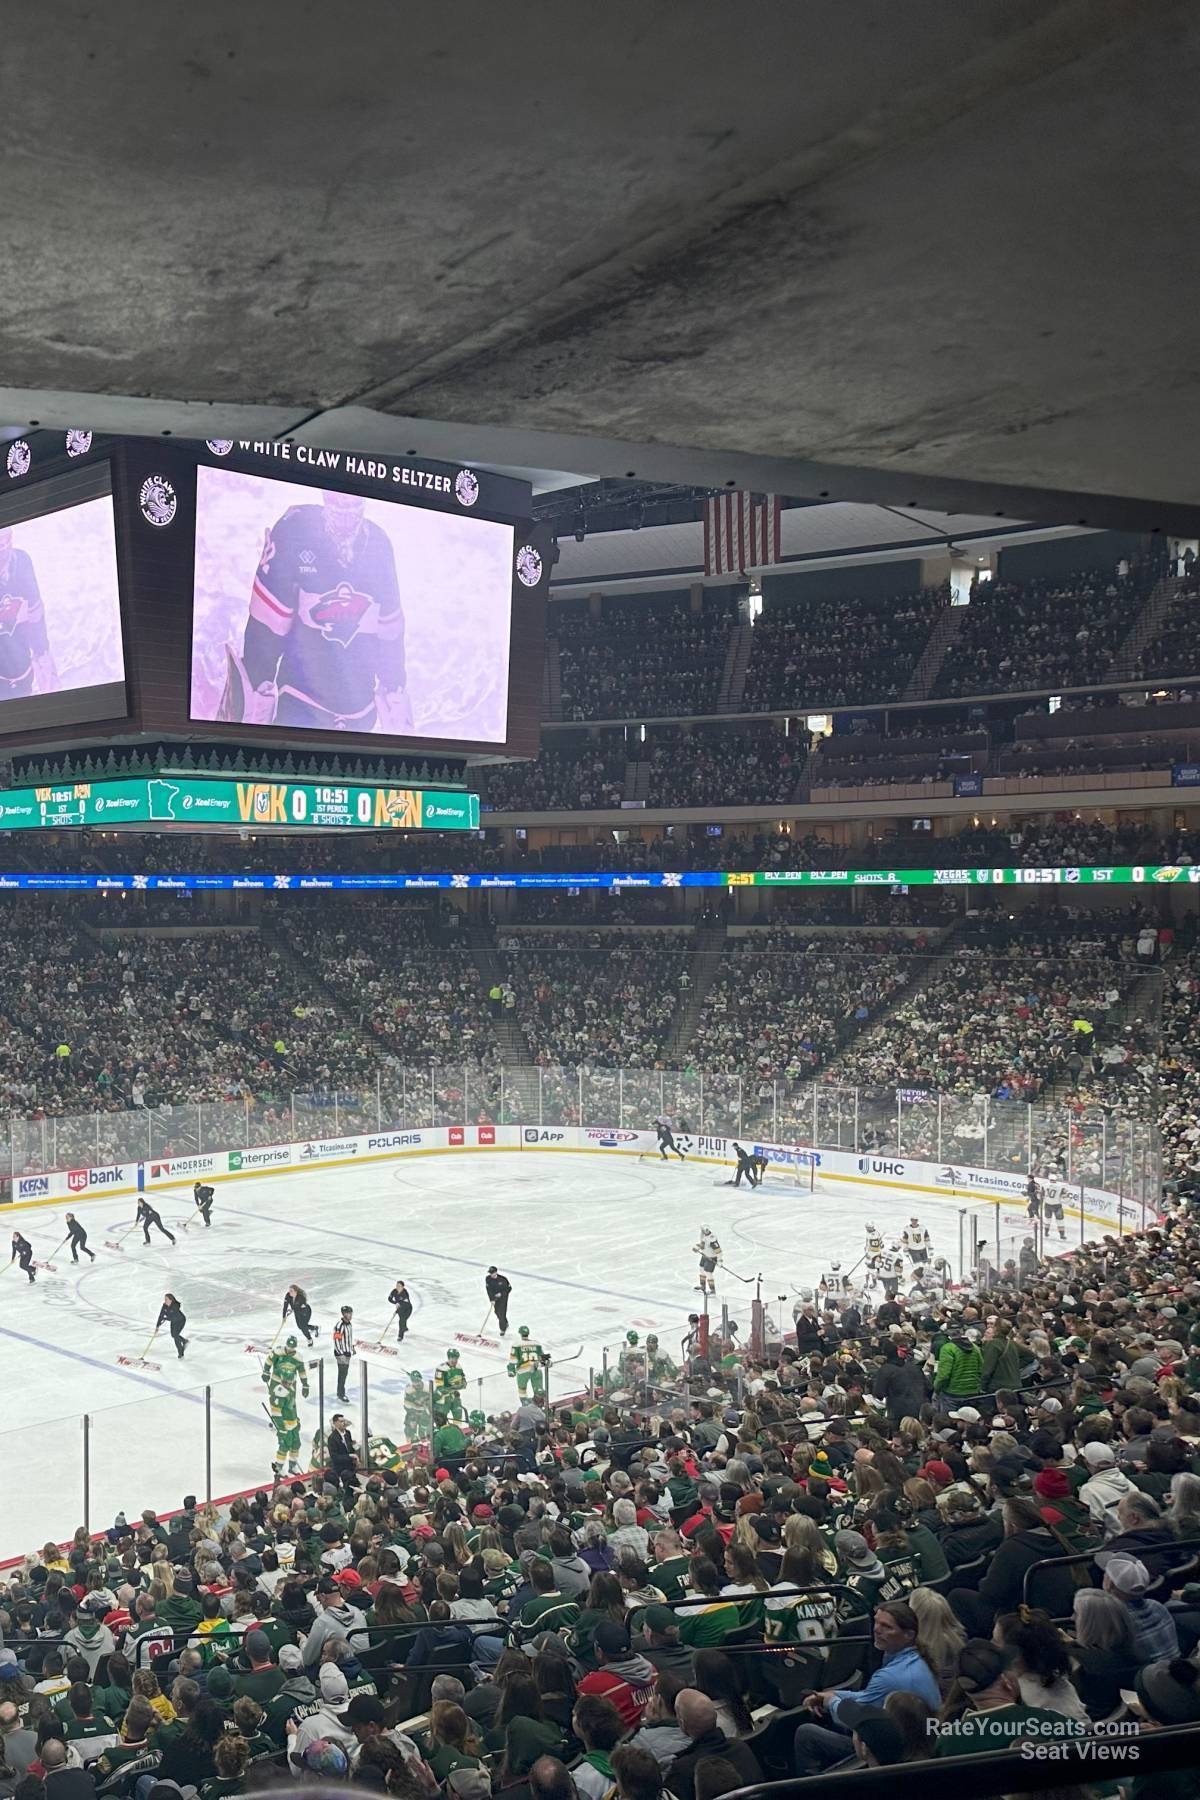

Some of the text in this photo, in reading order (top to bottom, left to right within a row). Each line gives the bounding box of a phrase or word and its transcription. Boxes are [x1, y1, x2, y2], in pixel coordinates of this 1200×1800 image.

[239, 440, 291, 459] WHITE
[297, 447, 340, 469] CLAW
[346, 457, 386, 479] HARD
[393, 467, 451, 493] SELTZER
[140, 476, 174, 505] WHITE CLAW
[52, 791, 72, 802] 10:51
[41, 802, 47, 816] 0
[79, 800, 85, 814] 0
[237, 783, 422, 828] VGK 0 10:51 0 MIN
[316, 804, 348, 813] 1ST PERIOD
[52, 815, 73, 824] SHOTS
[313, 814, 352, 825] 8 SHOTS 2
[993, 866, 1144, 883] 0 10:51 1ST 0
[368, 1134, 422, 1150] POLARIS
[699, 1137, 728, 1151] PILOT
[171, 1158, 213, 1171] ANDERSEN
[233, 1150, 290, 1166] enterprise
[873, 1161, 904, 1176] UHC
[69, 1166, 123, 1187] us bank
[827, 1278, 840, 1292] 21
